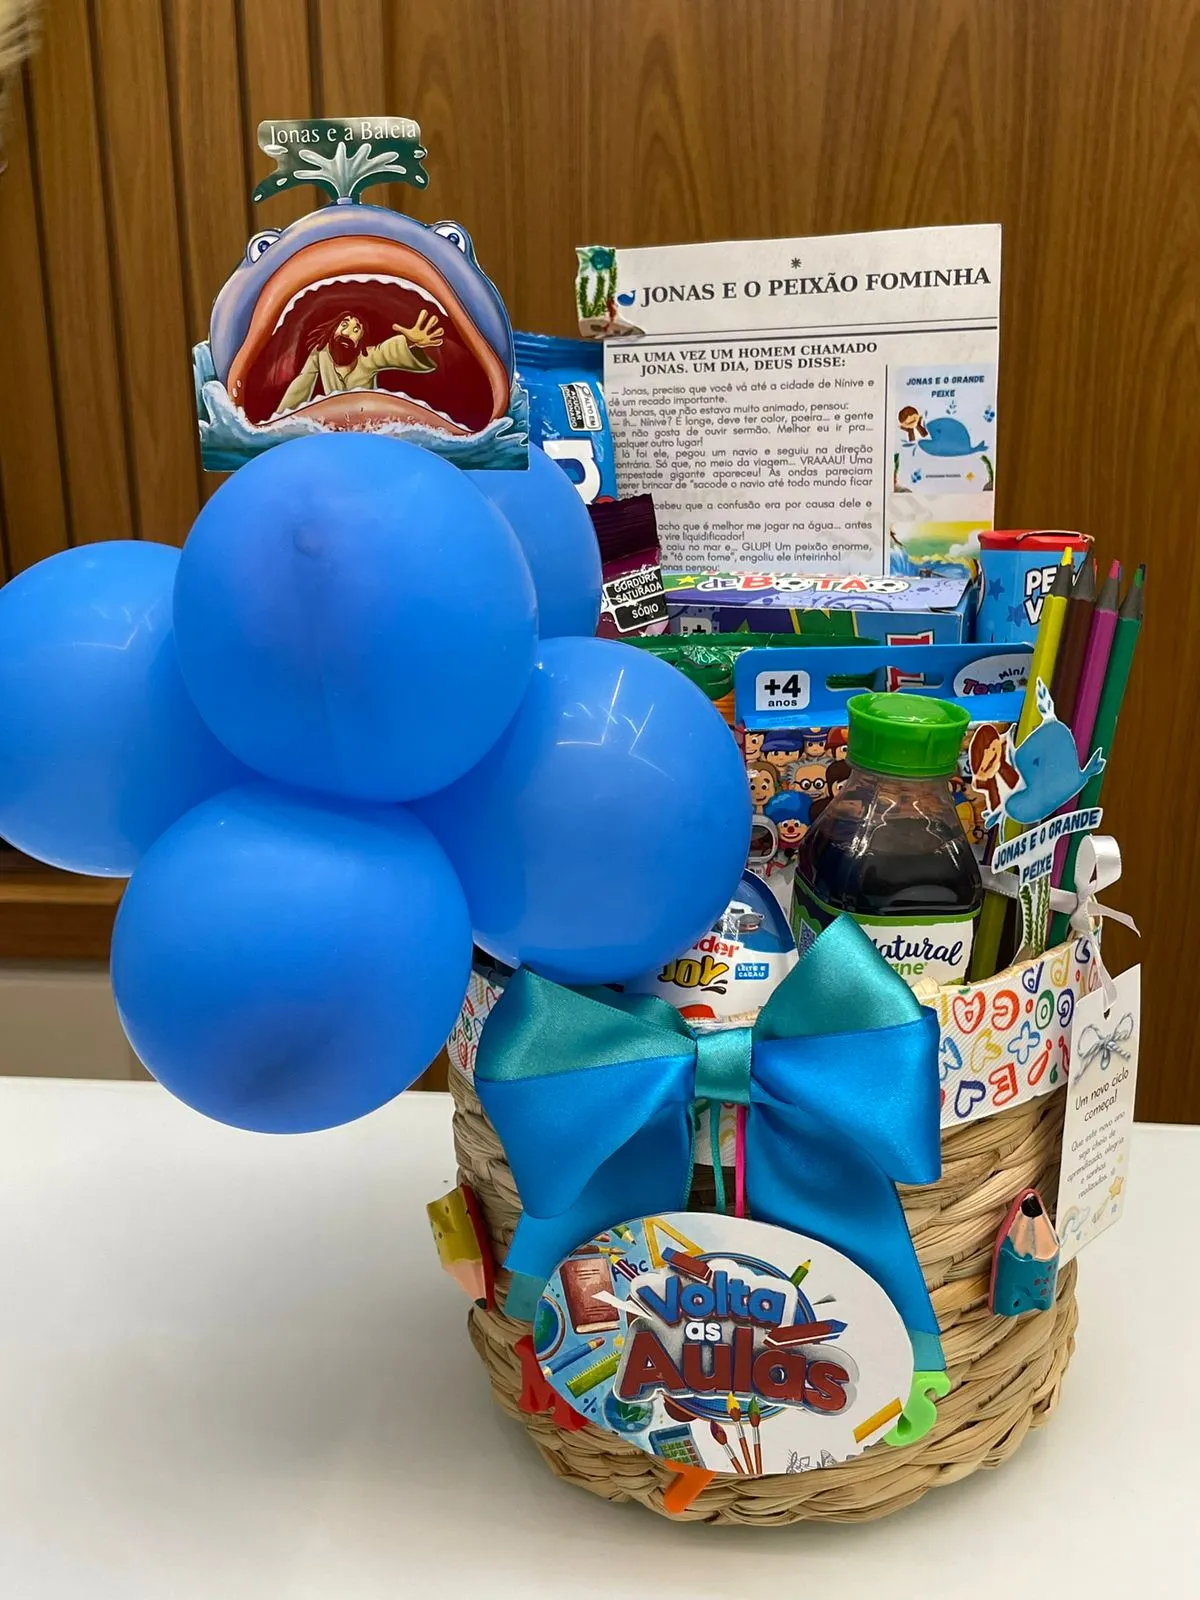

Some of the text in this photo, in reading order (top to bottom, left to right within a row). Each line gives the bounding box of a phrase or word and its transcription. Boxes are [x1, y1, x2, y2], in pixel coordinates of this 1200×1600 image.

[271, 122, 418, 145] Jonas e a Baleia
[640, 267, 992, 309] JONAS E O PEIXÃO FOMINHA
[613, 342, 878, 364] ERA UMA VEZ UM HOMEM CHAMADO
[640, 356, 846, 375] JONAS. UM DIA, DEUS DISSE:
[622, 376, 864, 398] Jonas, preciso que você até cidade Nínive
[906, 375, 985, 386] JONAS E O GRANDE
[931, 389, 956, 398] PEIXE
[608, 401, 849, 418] Mas Jonas, que não estava muito animado, pensou:
[640, 409, 874, 428] Nínive? longe, deve ter calor, gente
[612, 423, 811, 441] que não gosta ouvir sermão. Melhor
[636, 443, 874, 460] foi ele, pegou navio seguiu direção
[651, 437, 703, 450] outro lugar!
[671, 454, 873, 471] que, meio da VRAAAU! Uma
[642, 476, 873, 489] brincar de navio até todo mundo ficar
[670, 465, 873, 481] gigante apareceu! As ondas pareciam
[685, 502, 703, 512] que
[717, 499, 761, 509] confusão
[785, 501, 802, 511] por
[839, 498, 862, 508] dele
[659, 520, 680, 530] acho
[683, 523, 700, 533] que
[712, 520, 744, 530] melhor
[764, 523, 790, 533] jogar
[845, 519, 872, 529] antes
[665, 531, 680, 541] vire
[683, 531, 745, 544] liquidificador!
[666, 541, 686, 551] caiu
[742, 541, 771, 551] GLUP!
[775, 541, 792, 551] Um
[795, 541, 828, 554] peixão
[832, 544, 872, 553] enorme,
[739, 551, 775, 564] engoliu
[776, 551, 792, 561] ele
[794, 551, 841, 561] inteirinho!
[614, 571, 658, 593] GORDURA
[616, 582, 662, 603] SATURADA
[632, 604, 658, 618] SÓDIO
[764, 674, 802, 699] +4
[768, 698, 798, 708] anos
[994, 809, 1100, 870] JONAS E O GRANDE
[1022, 853, 1052, 883] PEIXE
[873, 934, 963, 966] atural
[658, 955, 730, 988] JOY
[1075, 1066, 1129, 1111] Um novo ciclo
[1084, 1088, 1118, 1122] começa!
[636, 1270, 786, 1328] Volta
[685, 1320, 721, 1342] as
[618, 1327, 850, 1412] Aulas
